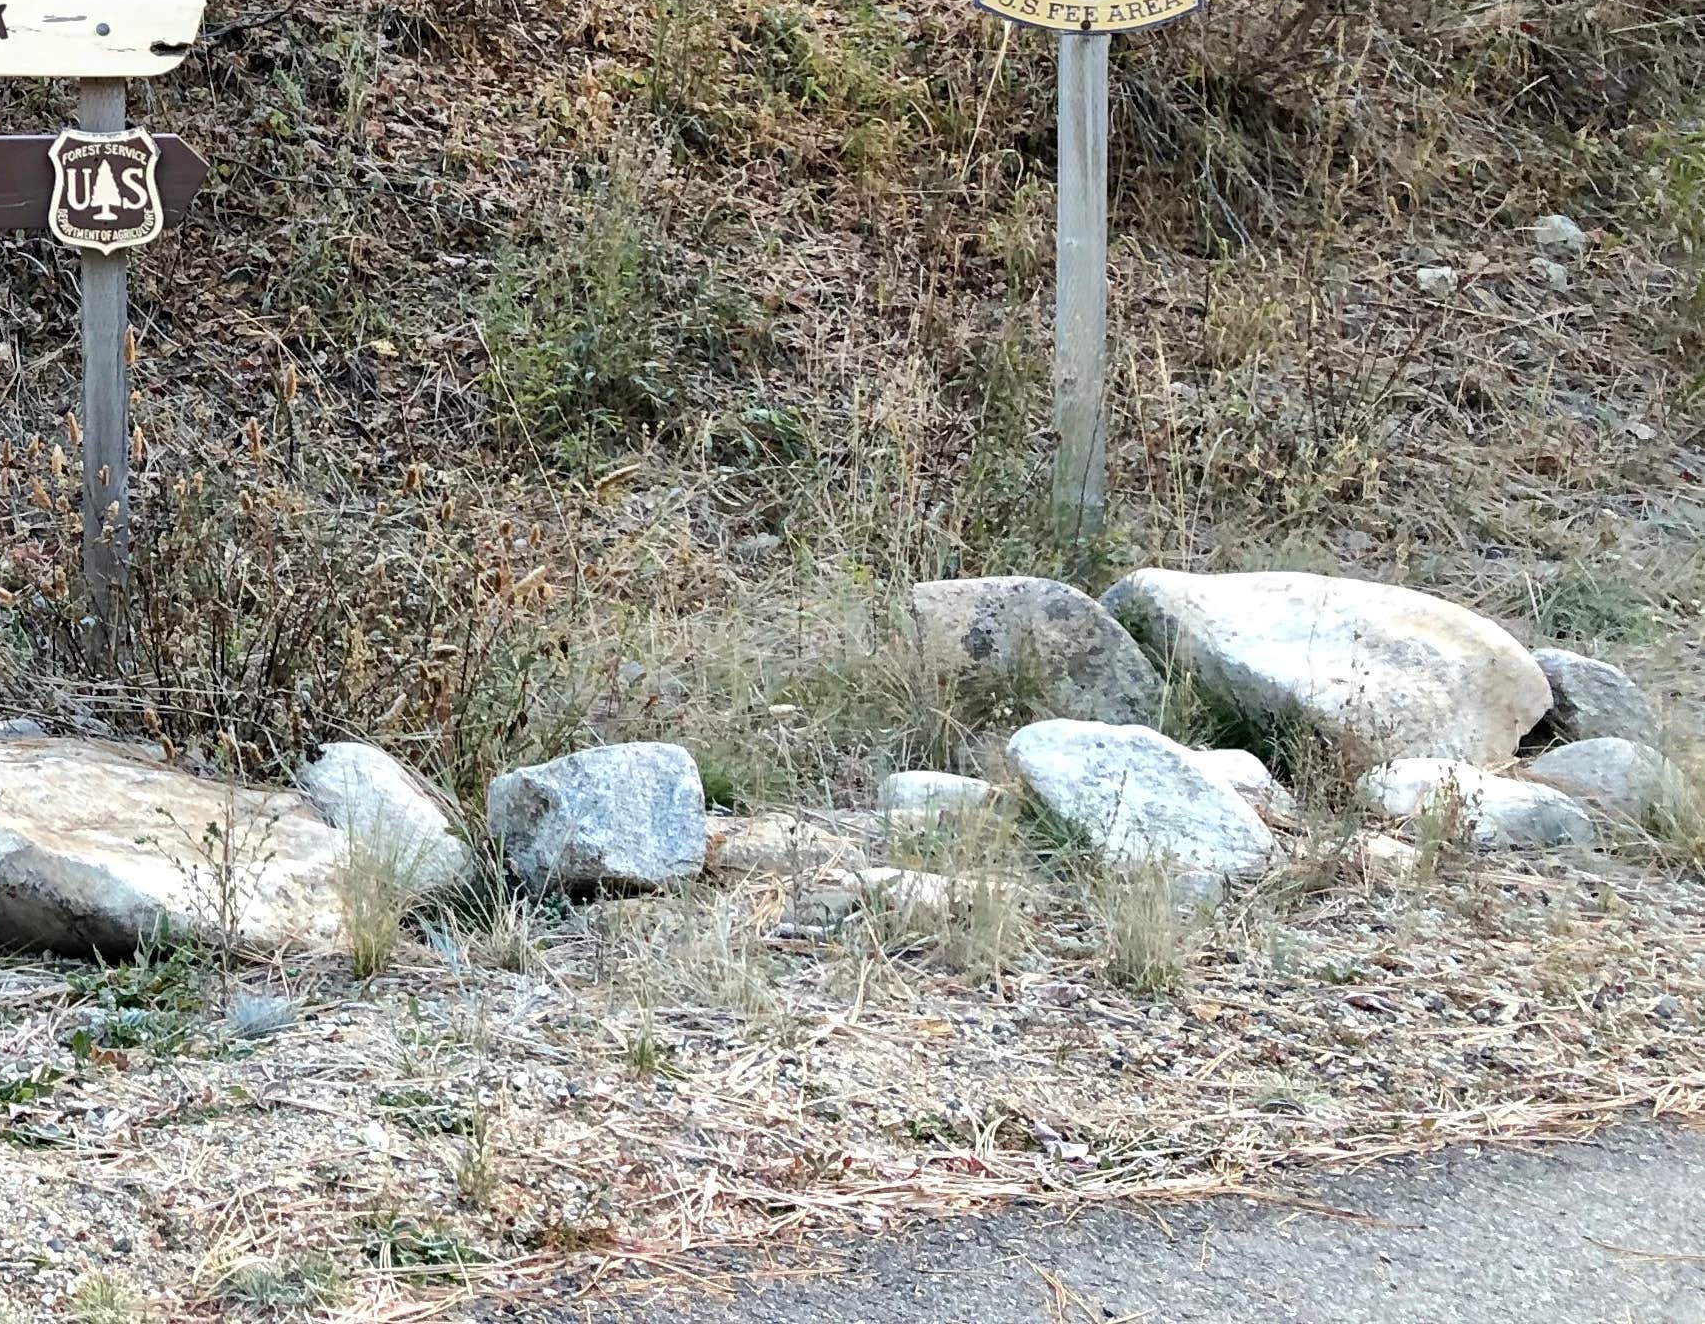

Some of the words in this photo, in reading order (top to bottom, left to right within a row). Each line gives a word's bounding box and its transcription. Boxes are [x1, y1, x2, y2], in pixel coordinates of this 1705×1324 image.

[1047, 2, 1099, 23] FEE
[62, 144, 102, 165] FOREST
[104, 143, 148, 165] SERVICE
[100, 229, 112, 241] OF
